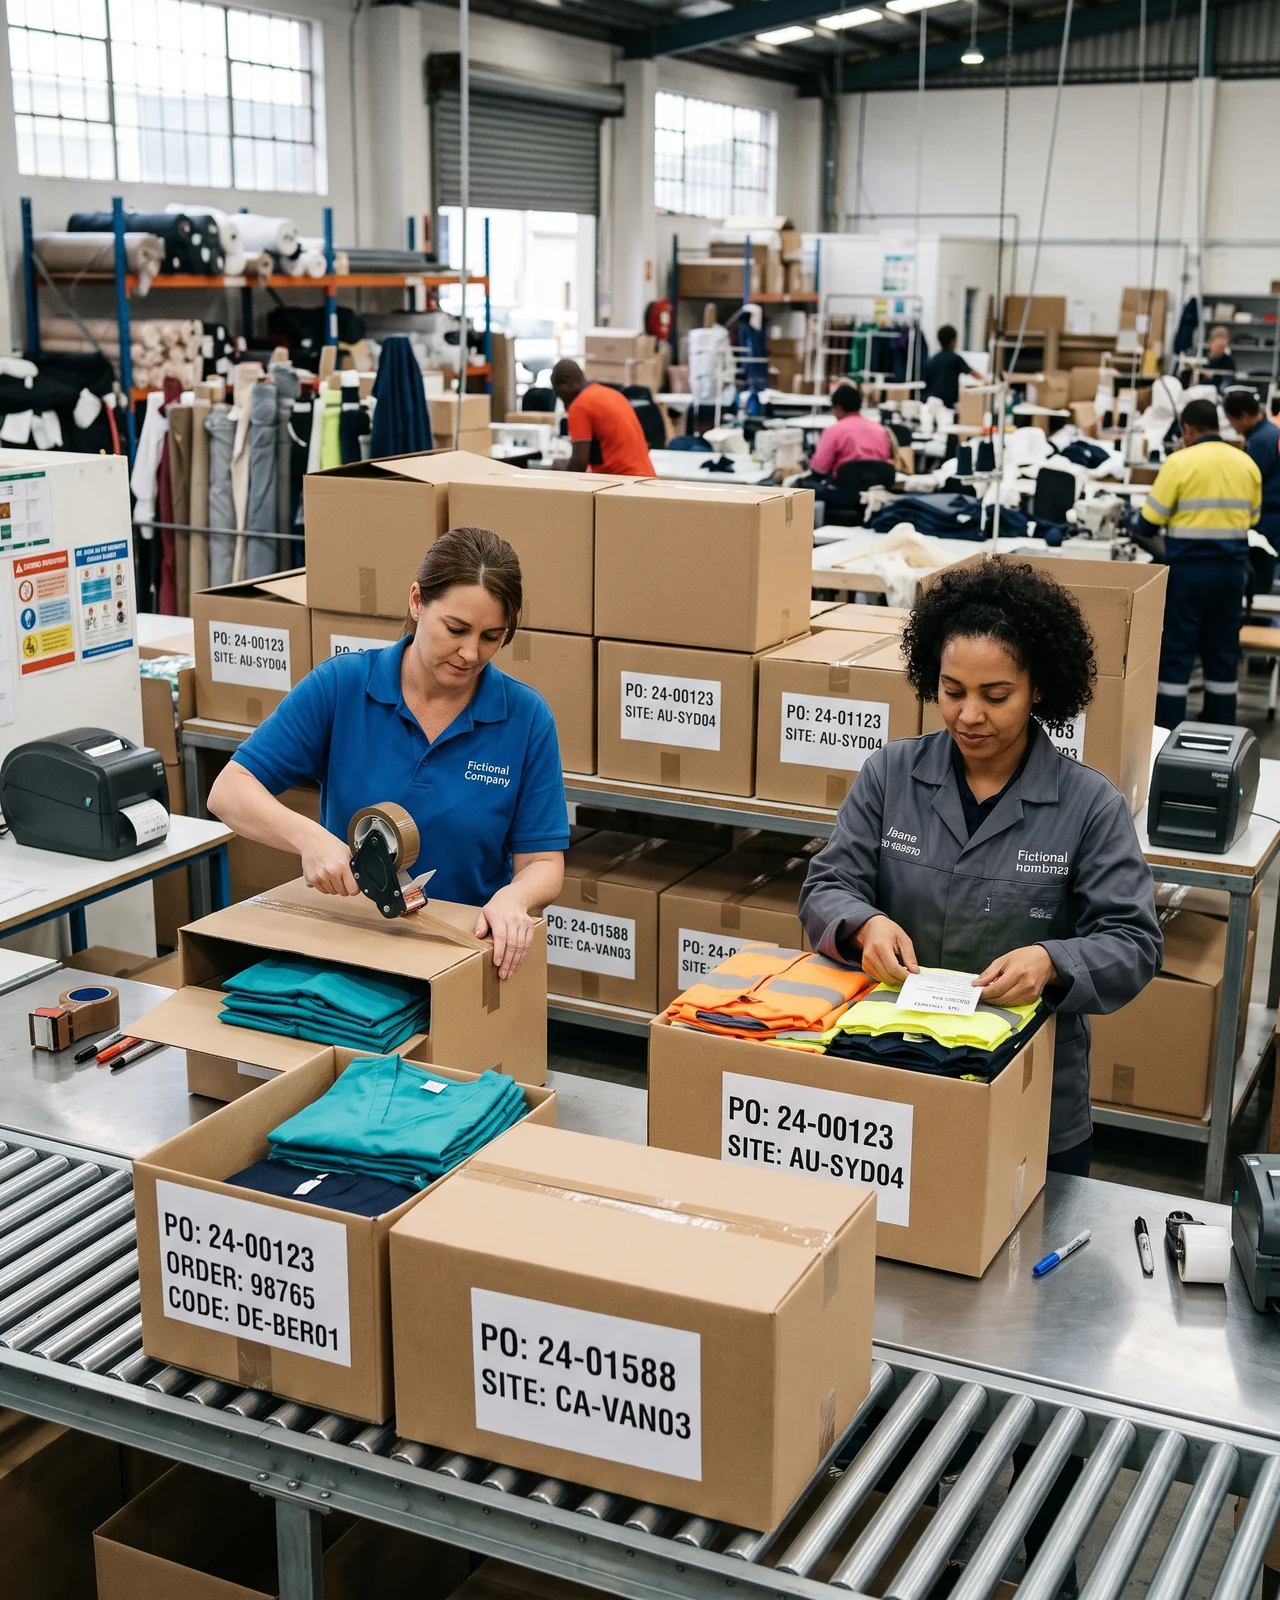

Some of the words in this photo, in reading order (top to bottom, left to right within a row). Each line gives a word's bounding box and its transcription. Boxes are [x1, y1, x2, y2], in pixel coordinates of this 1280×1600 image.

[213, 631, 231, 646] PO:
[234, 634, 284, 652] 24-00123
[214, 651, 237, 665] SITE:
[240, 654, 287, 671] AU-SYD04
[626, 683, 647, 699] PO:
[651, 686, 714, 706] 24-00123
[625, 705, 653, 720] SITE:
[657, 709, 716, 728] AU-SYD04
[787, 704, 810, 721] PO:
[815, 707, 881, 729] 24-01123
[785, 727, 816, 743] SITE:
[819, 731, 883, 750] AU-SYD04
[464, 770, 511, 788] Company
[467, 760, 510, 775] Fictional
[1017, 849, 1068, 863] Fictional
[547, 914, 567, 930] PO:
[571, 919, 628, 941] 24-01588
[547, 934, 573, 949] SITE:
[576, 939, 631, 960] CA-VAN03
[683, 939, 704, 955] PO:
[682, 959, 710, 975] SITE:
[729, 1095, 769, 1127] PO:
[777, 1105, 894, 1150] 24-00123
[728, 1134, 782, 1165] SITE:
[789, 1146, 904, 1189] AU-SYD04
[164, 1211, 201, 1245] PO:
[208, 1223, 315, 1273] 24-00123
[167, 1250, 243, 1292] ORDER:
[251, 1273, 315, 1310] 98765
[168, 1285, 229, 1322] CODE:
[237, 1303, 338, 1351] DE-BER01
[481, 1322, 527, 1360] PO:
[538, 1335, 676, 1392] 24-01588
[482, 1368, 546, 1407] SITE:
[555, 1385, 691, 1440] CA-VAN03
